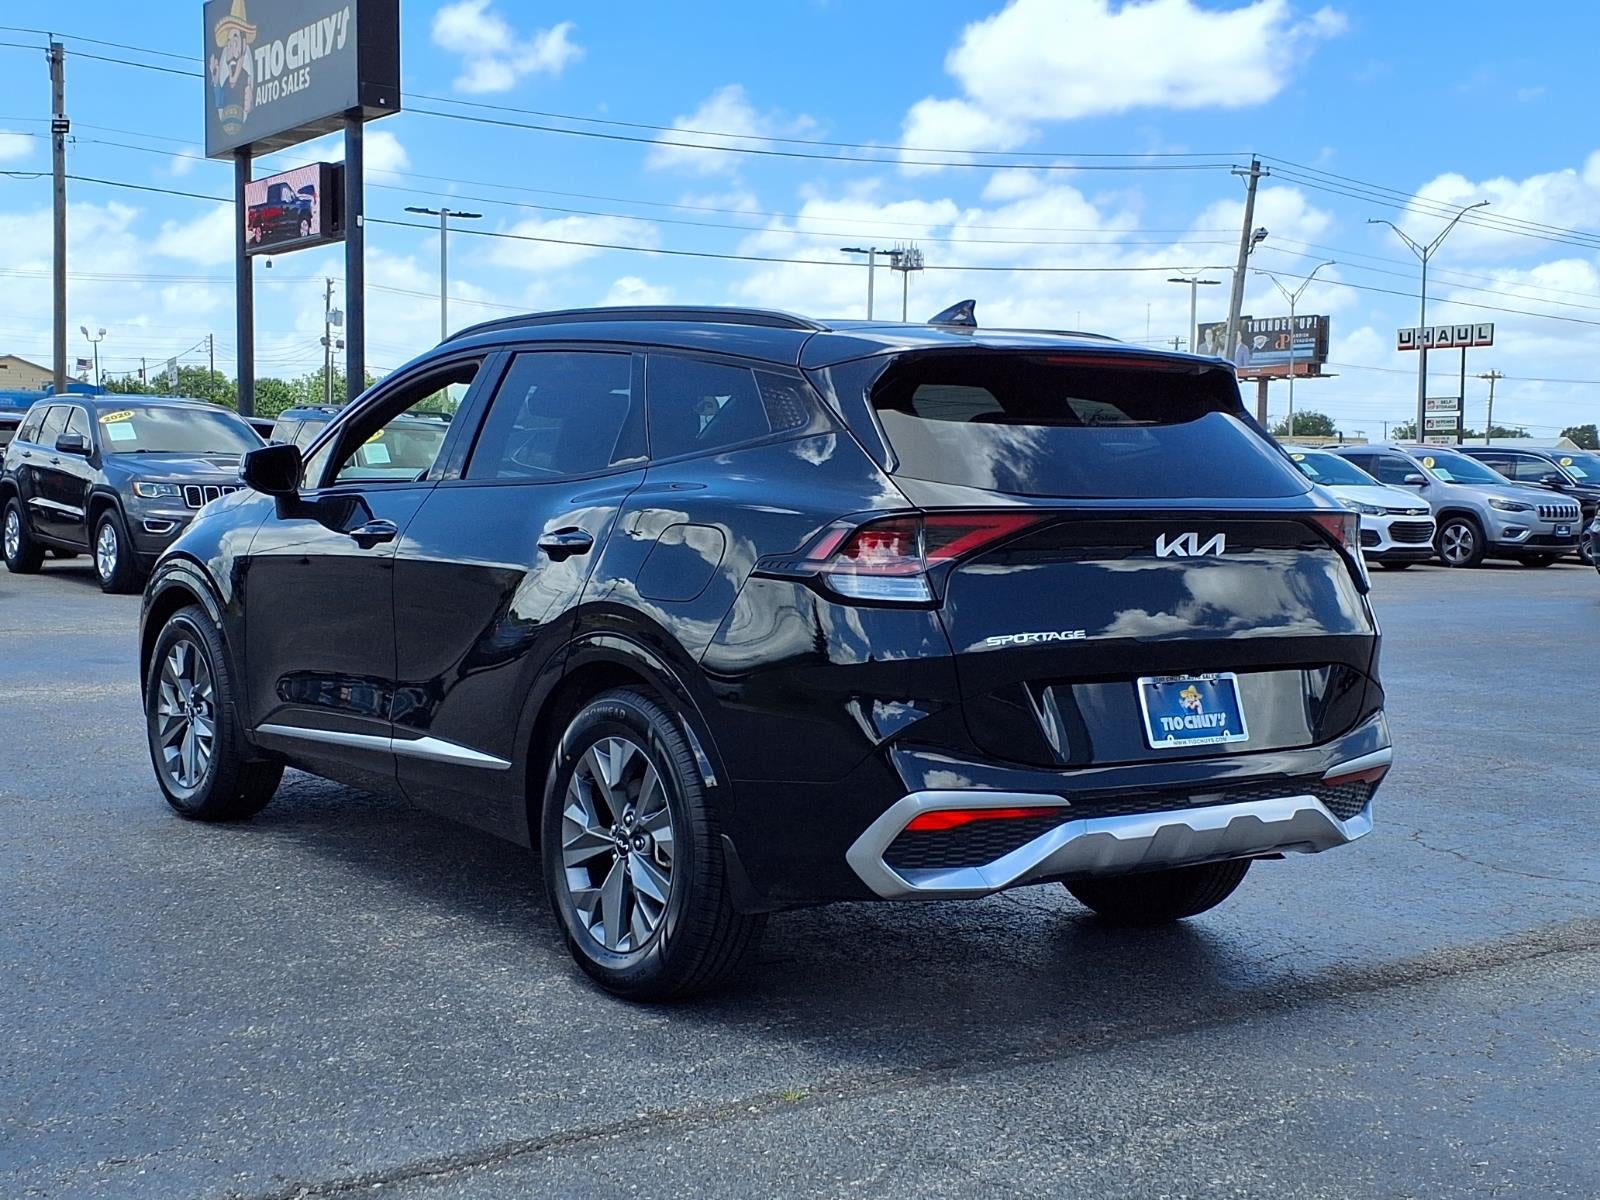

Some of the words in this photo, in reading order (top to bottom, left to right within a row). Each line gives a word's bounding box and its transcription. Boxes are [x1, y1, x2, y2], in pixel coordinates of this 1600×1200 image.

[255, 41, 284, 83] TIO
[286, 6, 349, 69] CHUY'S
[256, 81, 280, 106] AUTO
[281, 67, 310, 97] SALES
[104, 412, 131, 421] 2020
[1155, 532, 1226, 557] KIA
[986, 630, 1087, 646] SPORTAGE
[1160, 716, 1184, 731] TIO
[1185, 713, 1226, 729] CHUY'S
